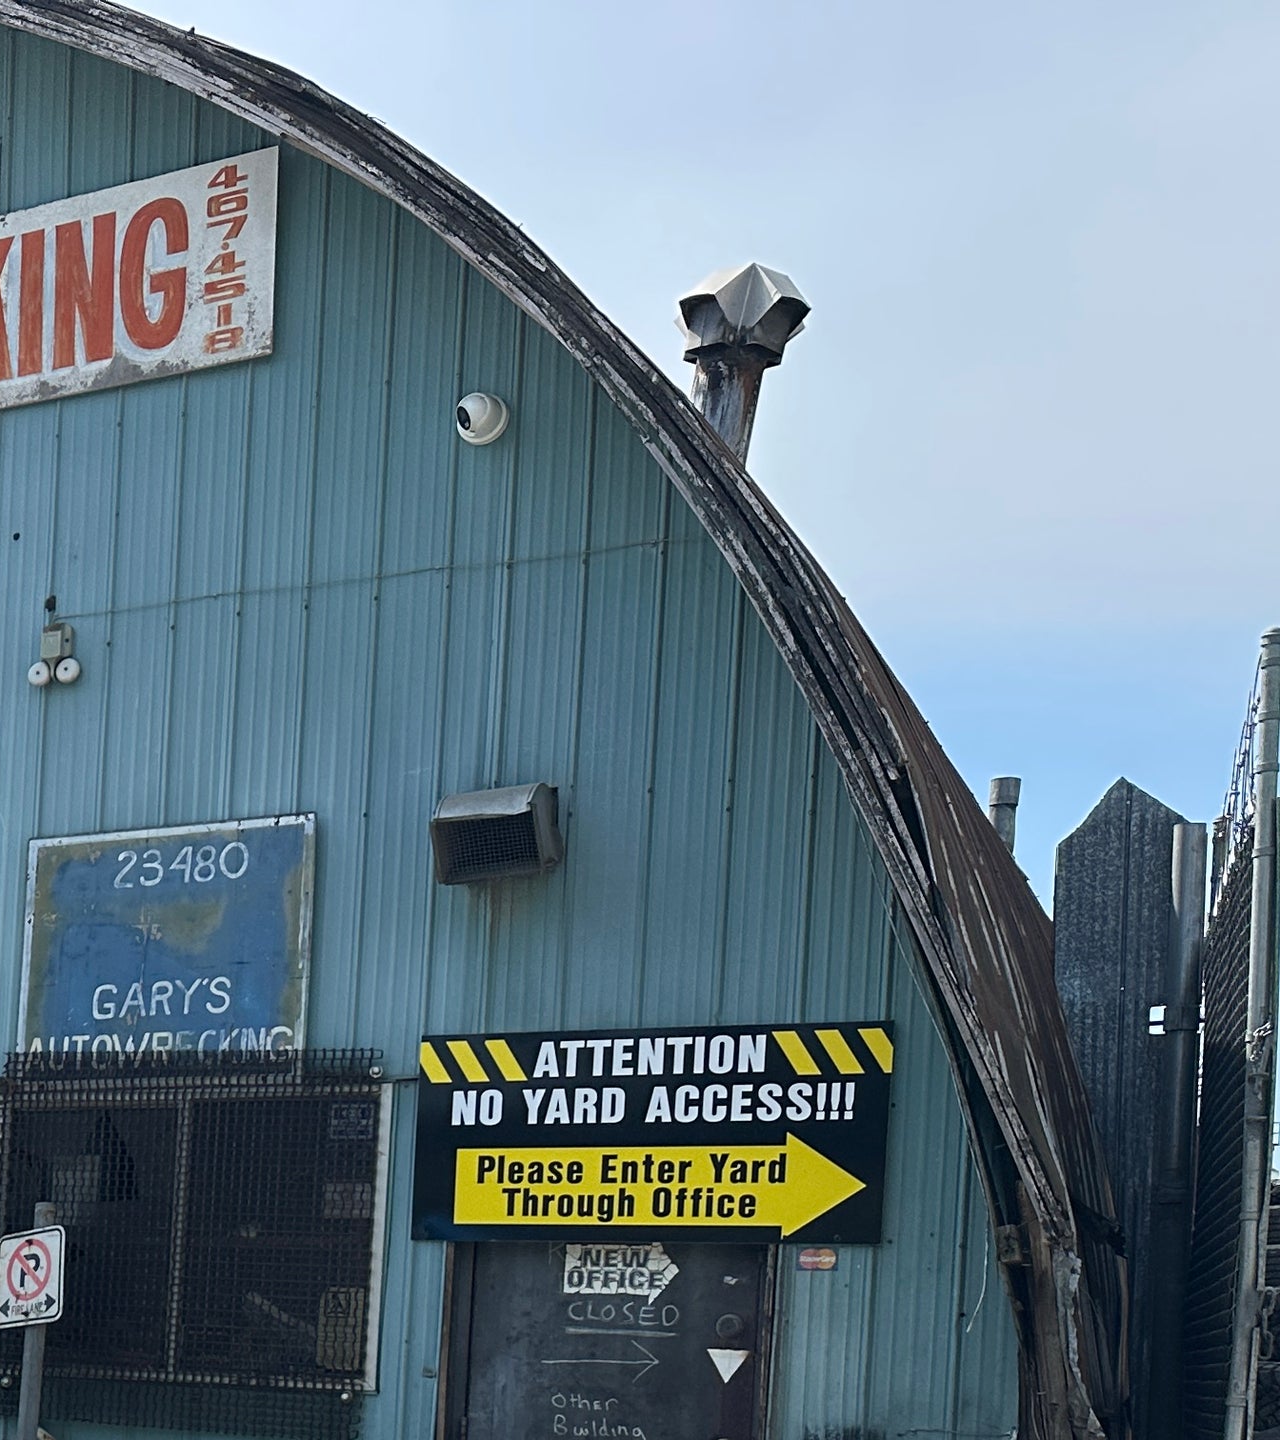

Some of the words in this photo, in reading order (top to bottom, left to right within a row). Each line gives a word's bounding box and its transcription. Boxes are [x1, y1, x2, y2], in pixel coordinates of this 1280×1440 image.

[113, 841, 249, 889] 23480
[91, 976, 232, 1020] GARY'S
[532, 1034, 767, 1079] ATTENTION
[451, 1090, 504, 1126] NO
[522, 1087, 626, 1125] YARD
[645, 1082, 856, 1123] ACCESS!!!
[476, 1155, 584, 1184] Please
[600, 1153, 693, 1184] Enter
[709, 1152, 787, 1184] Yard
[502, 1187, 636, 1223] Through
[651, 1187, 757, 1218] Office
[581, 1248, 650, 1269] NEW
[567, 1266, 664, 1290] OFFICE
[568, 1301, 680, 1326] CLOSED
[551, 1392, 618, 1411] Other
